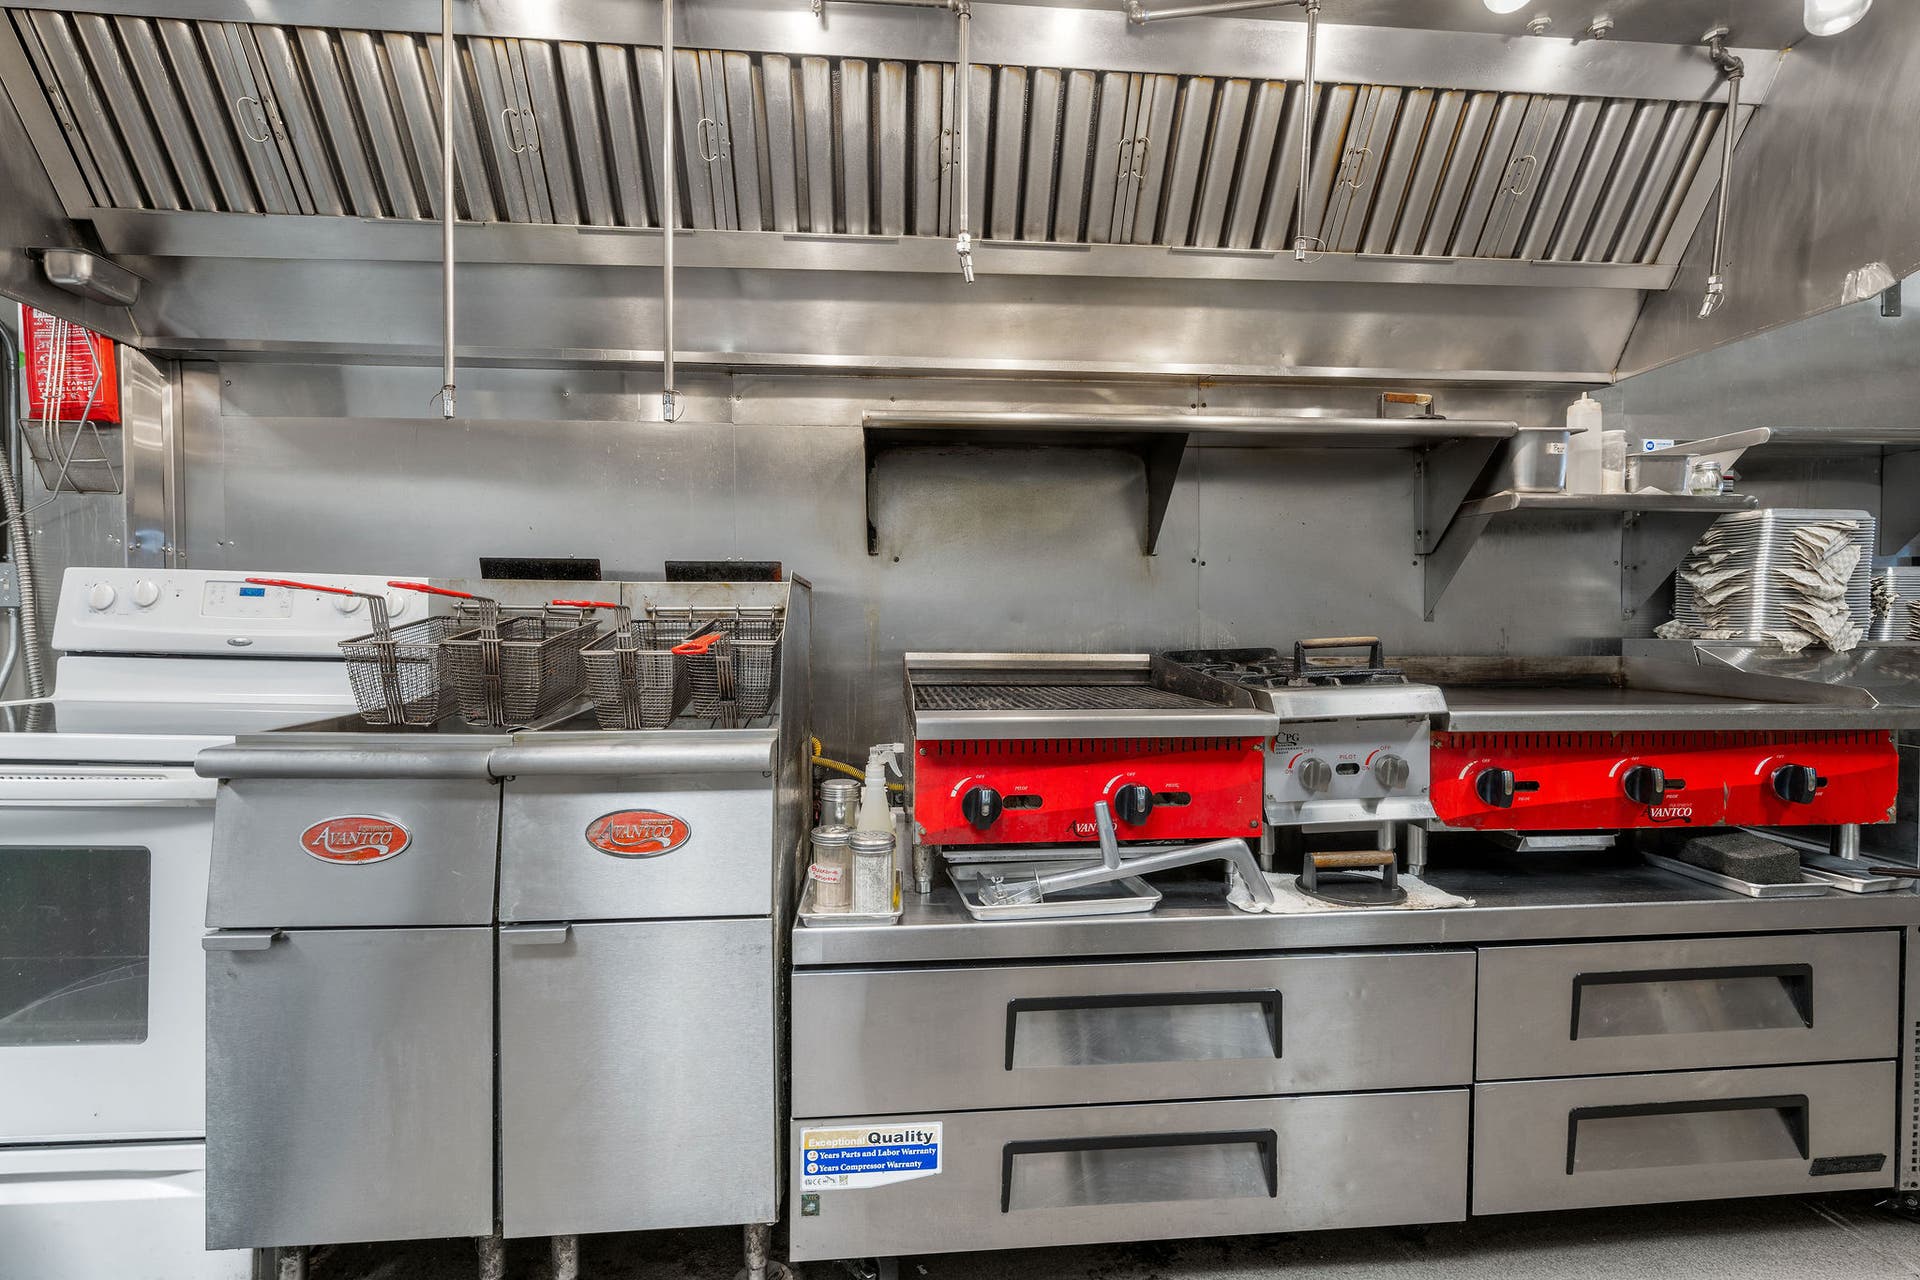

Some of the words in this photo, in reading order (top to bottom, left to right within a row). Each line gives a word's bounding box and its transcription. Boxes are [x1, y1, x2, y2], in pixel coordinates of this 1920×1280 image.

[1276, 732, 1299, 745] CPG
[599, 815, 674, 847] AVANTCO
[312, 826, 393, 854] AVANTCO
[808, 1137, 865, 1148] Exceptional
[868, 1131, 933, 1144] Quality
[862, 1149, 876, 1157] and
[901, 1147, 937, 1156] Warranty
[819, 1164, 839, 1172] Years
[840, 1162, 885, 1172] Compressor
[887, 1160, 923, 1169] Warranty
